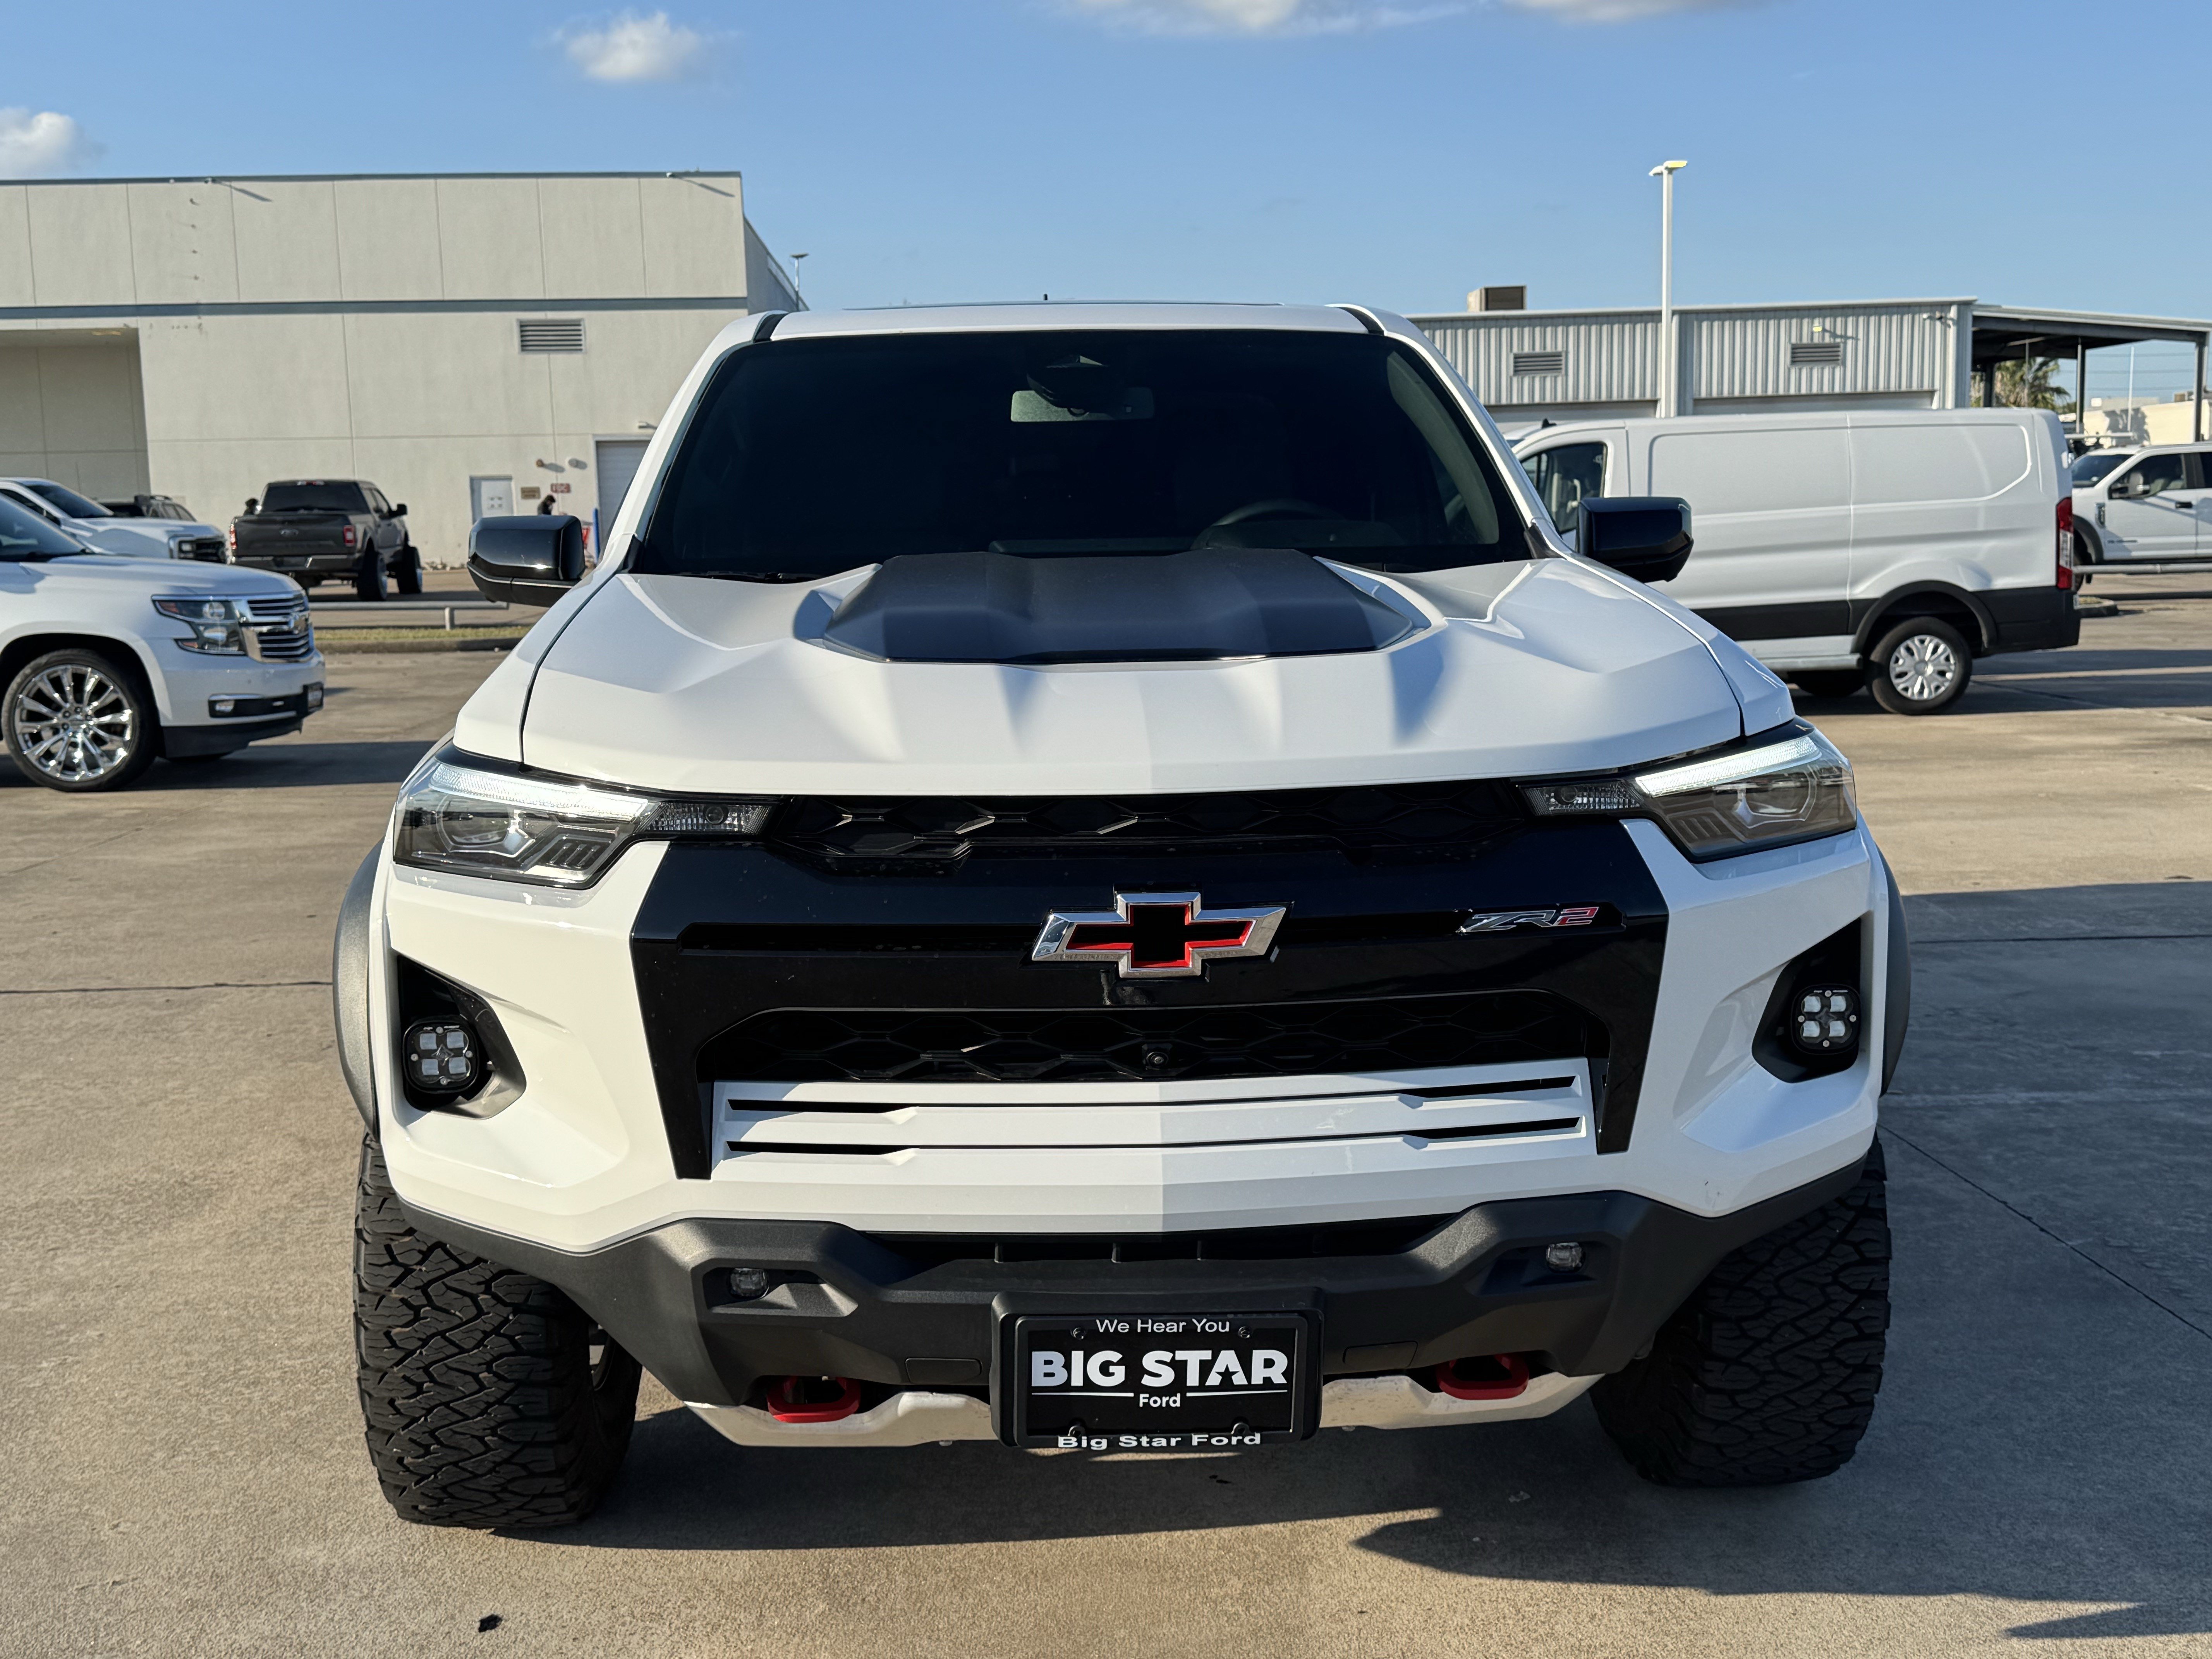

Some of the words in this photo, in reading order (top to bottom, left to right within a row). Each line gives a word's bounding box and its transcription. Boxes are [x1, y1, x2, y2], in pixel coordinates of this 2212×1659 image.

[1462, 907, 1599, 932] ZR2
[1096, 1319, 1130, 1333] We
[1137, 1319, 1187, 1333] Hear
[1192, 1318, 1230, 1332] You
[1031, 1350, 1125, 1387] BIG
[1141, 1350, 1288, 1387] STAR
[1139, 1394, 1181, 1408] Ford
[1058, 1436, 1108, 1450] Big
[1118, 1435, 1182, 1447] Star
[1192, 1432, 1261, 1446] Ford
